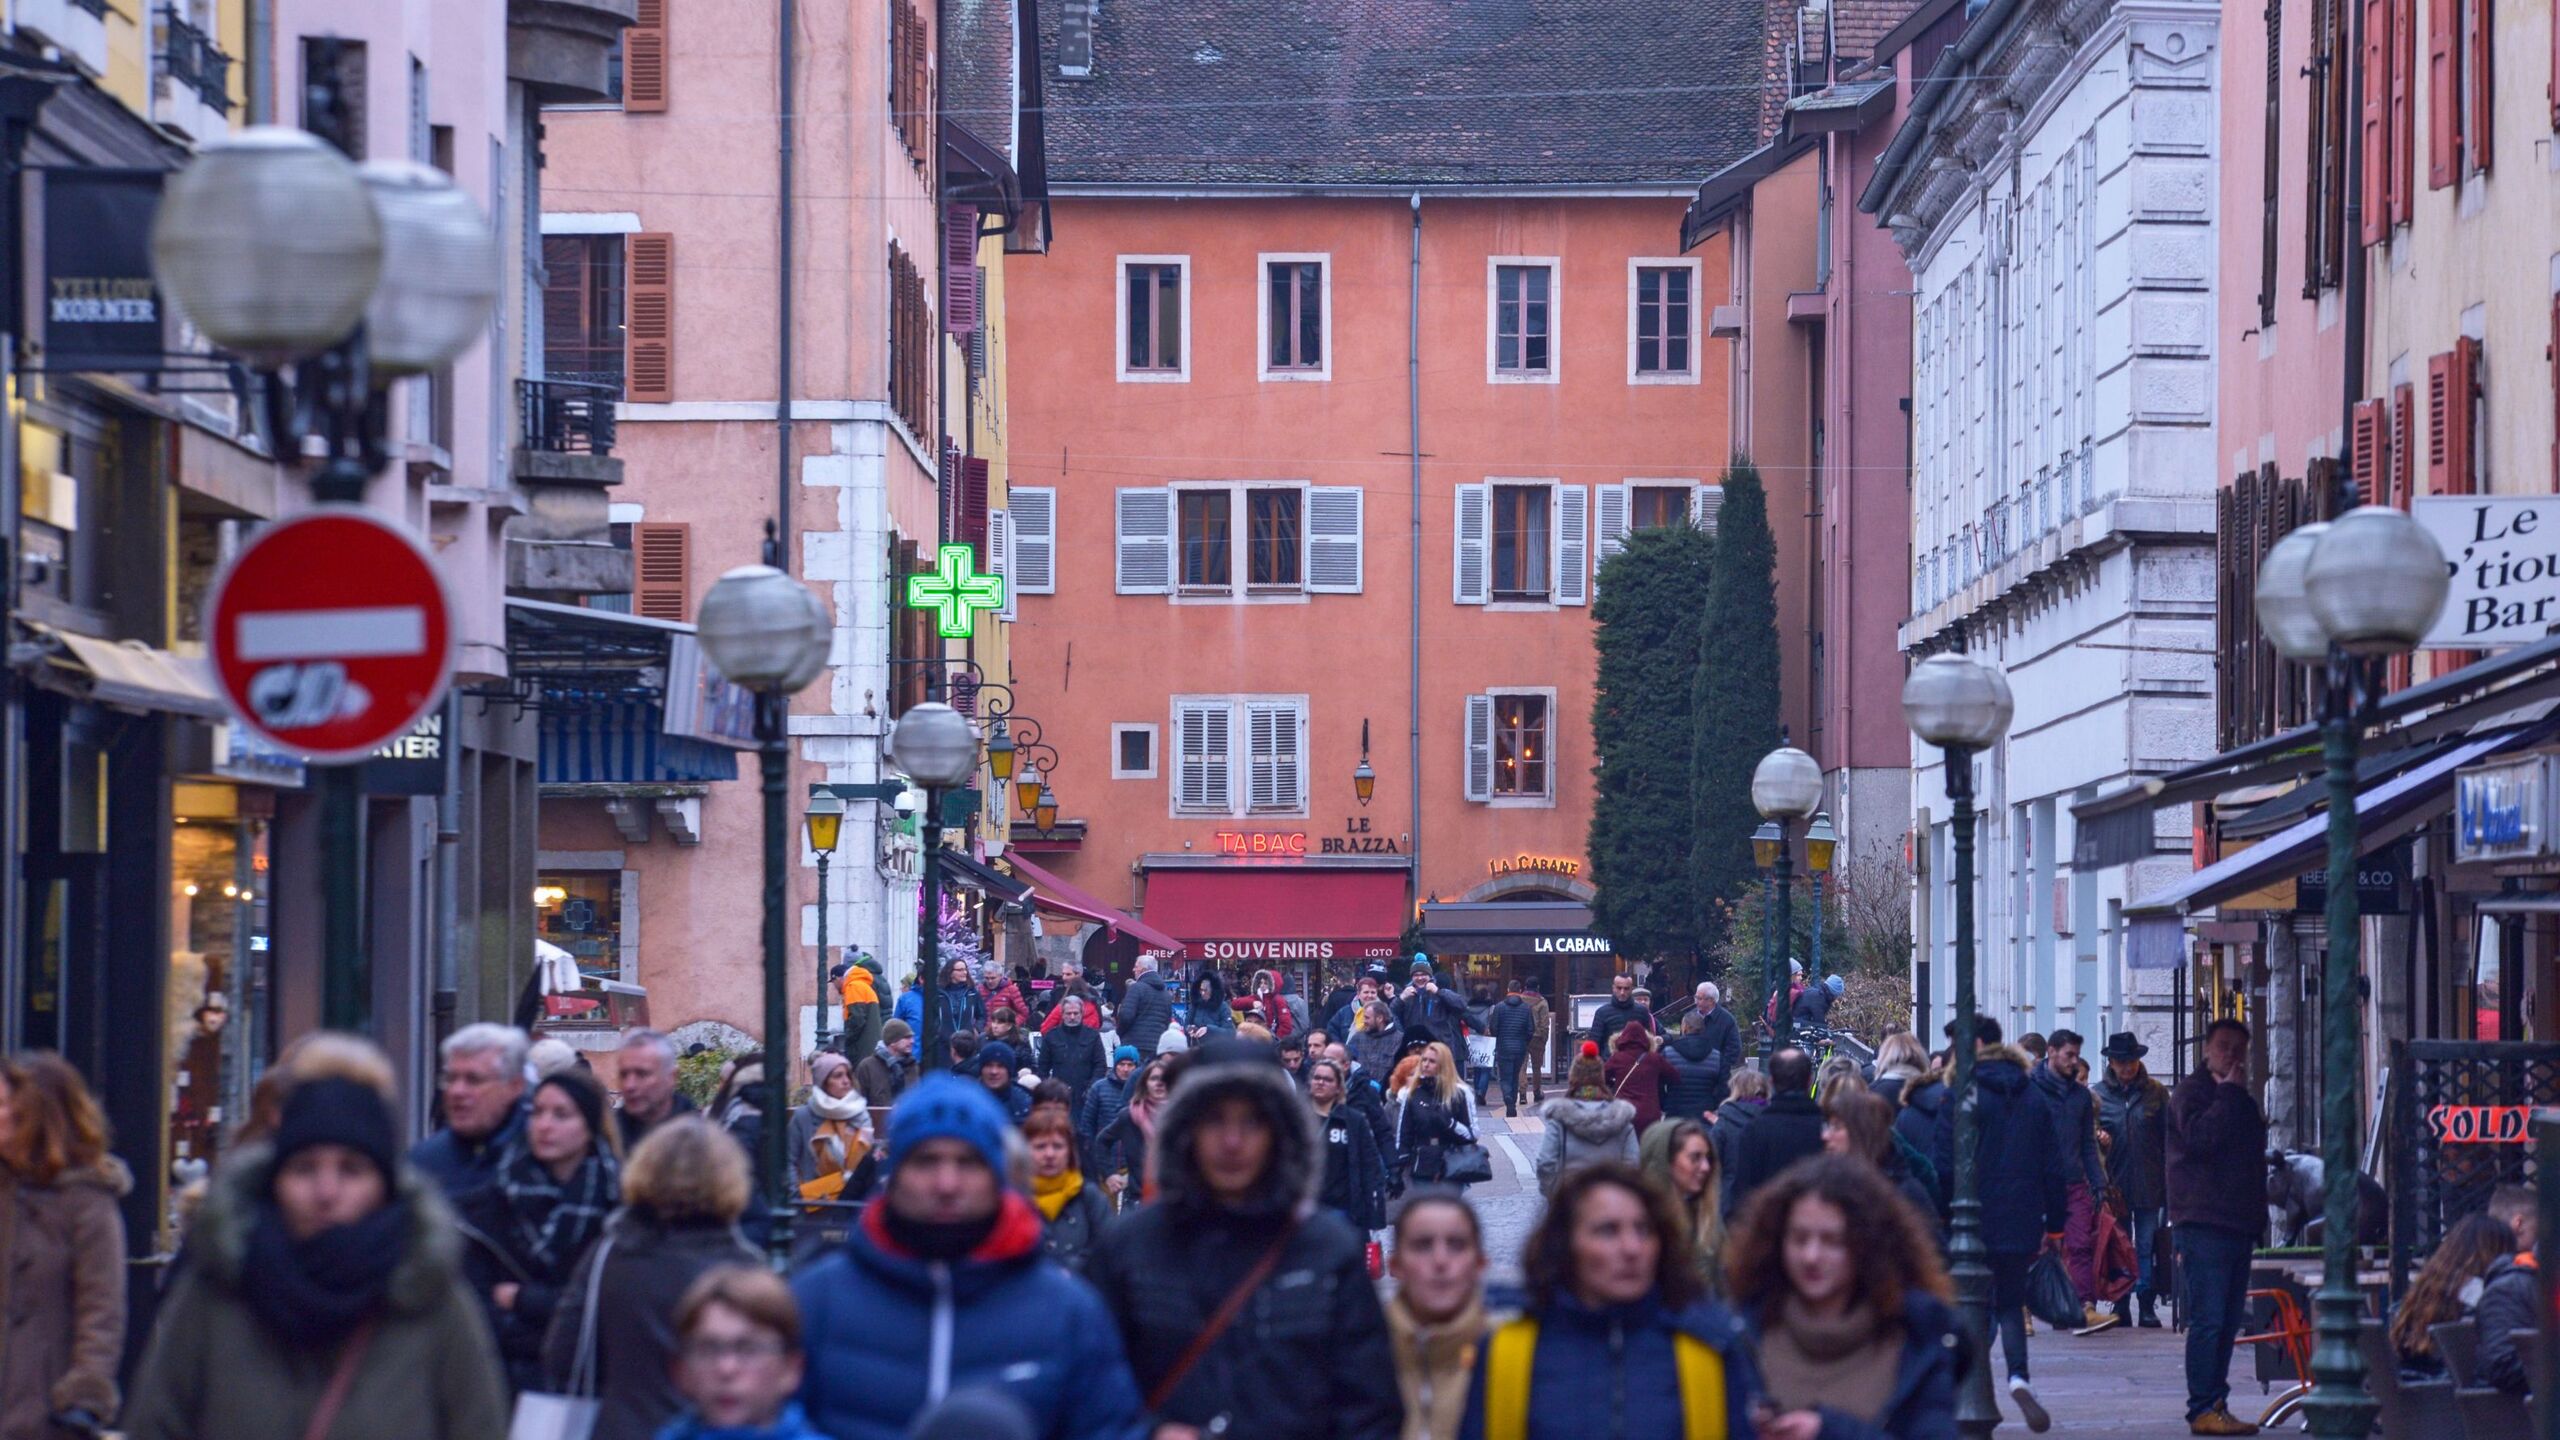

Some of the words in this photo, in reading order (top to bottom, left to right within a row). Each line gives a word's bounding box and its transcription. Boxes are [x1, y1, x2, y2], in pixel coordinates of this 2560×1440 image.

[52, 299, 155, 321] KORNER
[2471, 505, 2538, 544] Le
[2462, 597, 2556, 636] Bar
[1347, 818, 1371, 833] LE
[1217, 833, 1305, 853] TABAC
[1321, 838, 1399, 854] BRAZZA
[1490, 860, 1510, 879] LA
[1518, 855, 1580, 879] CABANE
[2358, 869, 2369, 885] &
[2371, 870, 2393, 885] CO
[1204, 942, 1334, 958] SOUVENIRS
[1365, 948, 1393, 957] LOTO
[1535, 938, 1553, 952] LA
